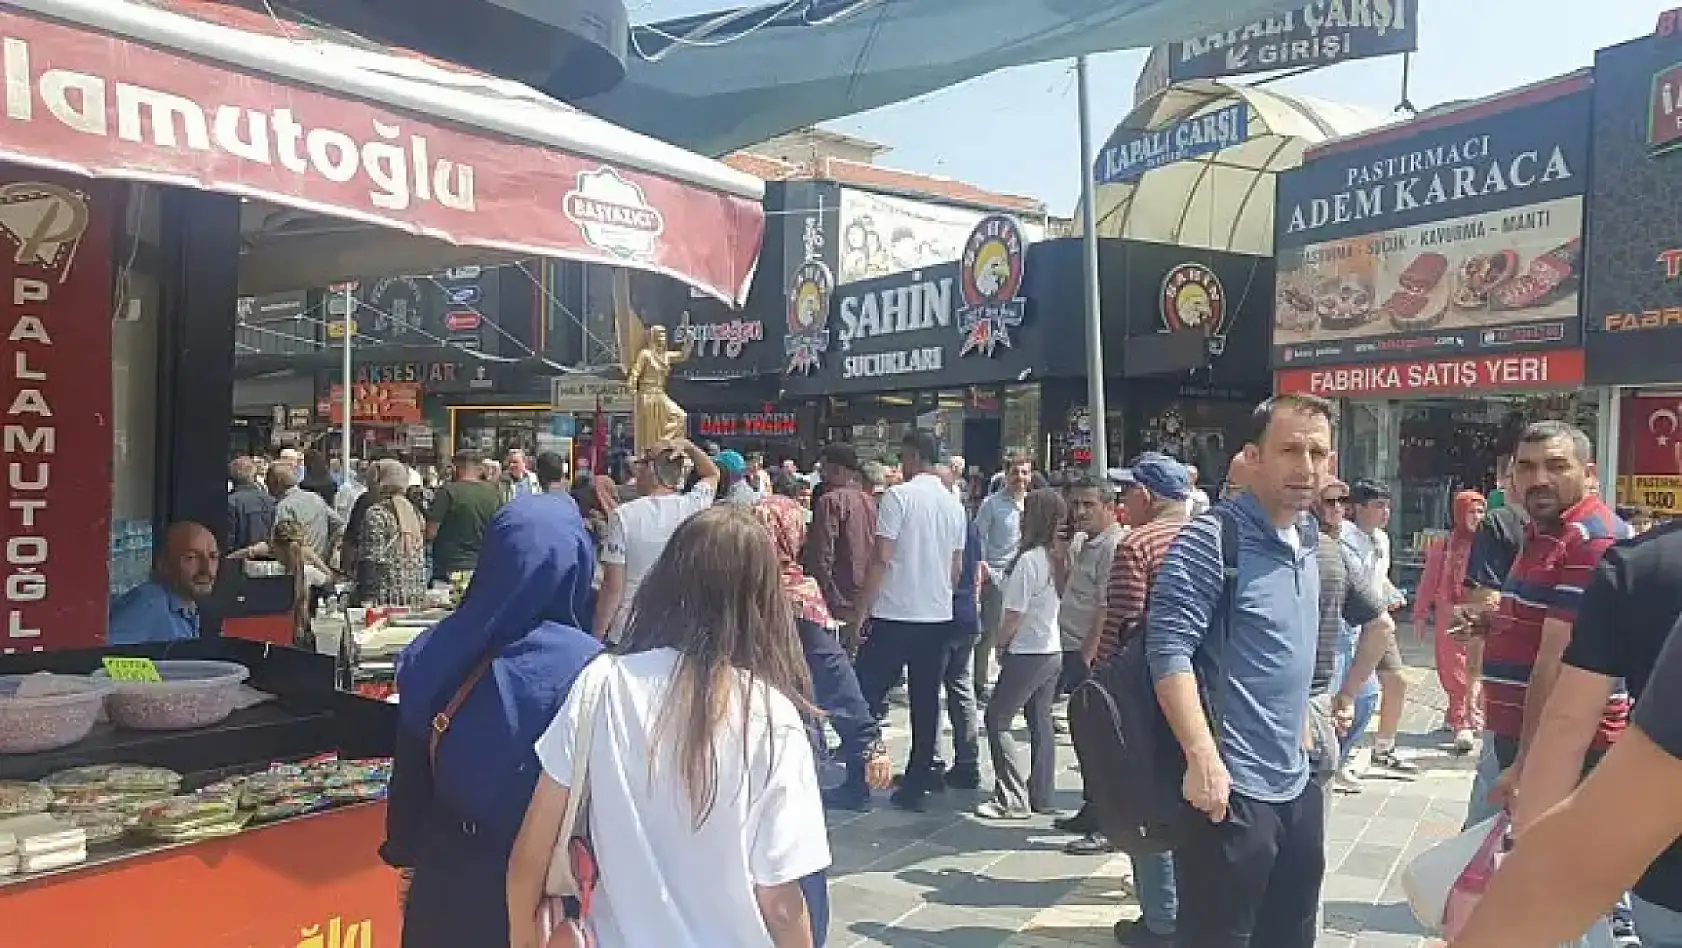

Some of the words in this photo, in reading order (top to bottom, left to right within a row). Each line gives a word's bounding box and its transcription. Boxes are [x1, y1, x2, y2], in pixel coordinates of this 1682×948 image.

[3, 36, 477, 212] lamutoğlu
[1104, 131, 1170, 181] KAPALI
[1176, 106, 1239, 153] ÇARŞI
[1347, 134, 1491, 187] PASTIRMACI
[1287, 184, 1386, 233] ADEM
[1393, 144, 1571, 213] KARACA
[1420, 219, 1486, 248] KAVURMA
[838, 270, 952, 351] ŞAHİN
[843, 346, 944, 379] SUCUKLARI
[1407, 362, 1479, 387] SATIŞ
[1485, 355, 1549, 382] YERİ
[3, 278, 55, 653] PALAMUTOĞL
